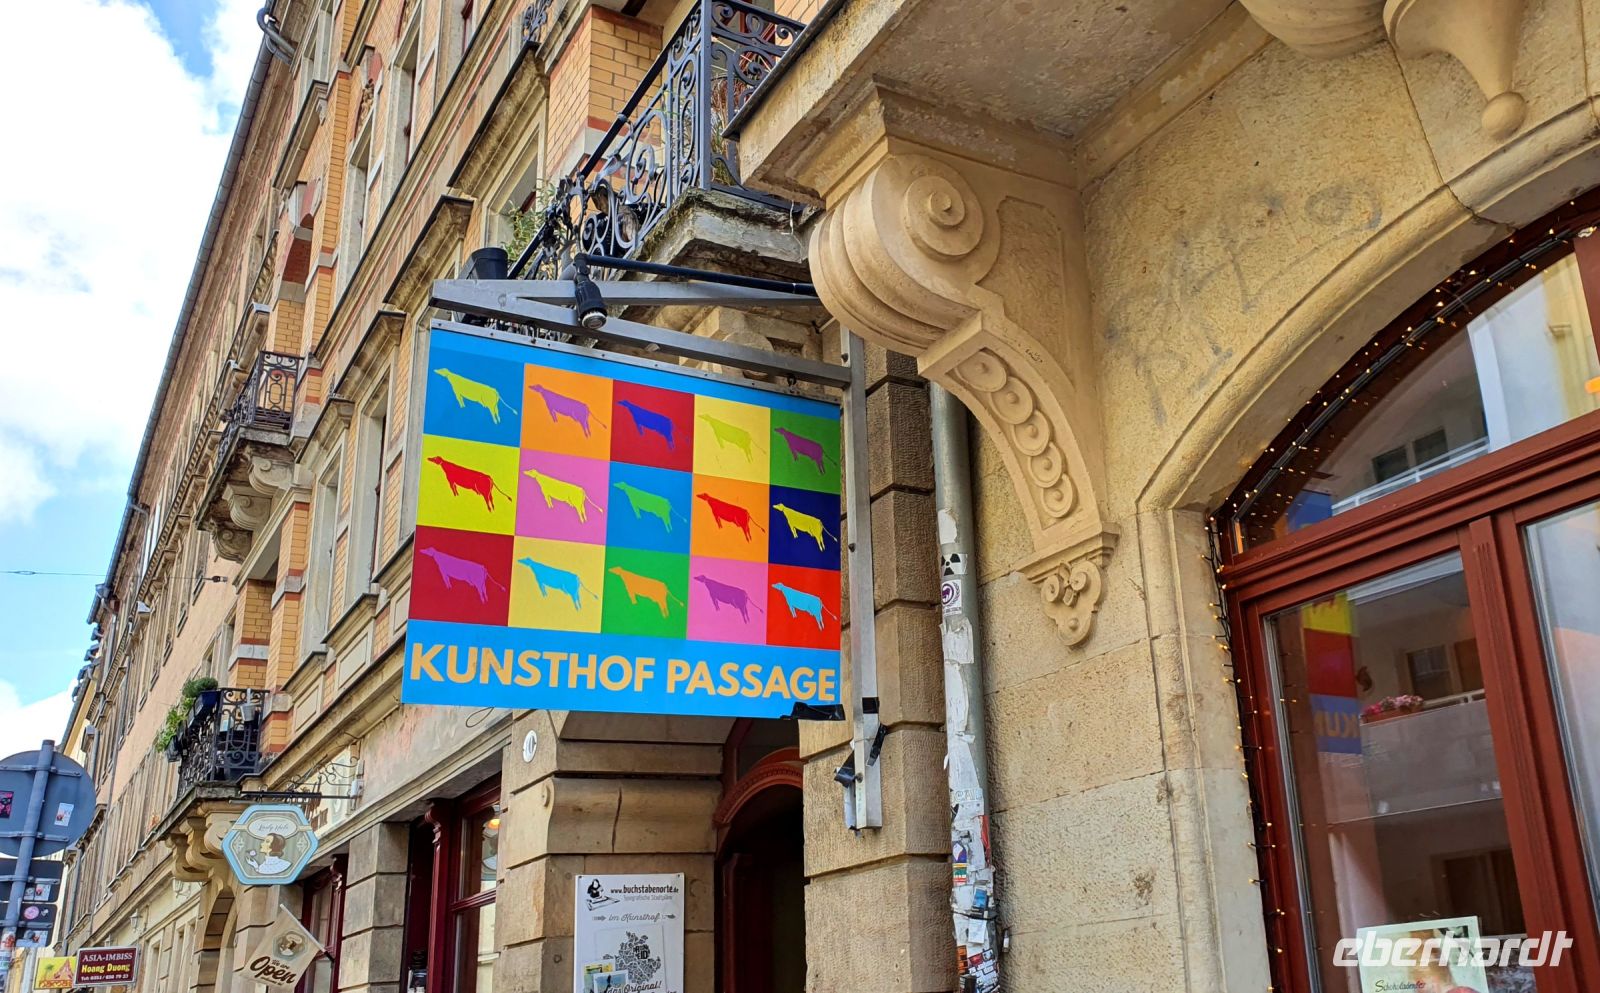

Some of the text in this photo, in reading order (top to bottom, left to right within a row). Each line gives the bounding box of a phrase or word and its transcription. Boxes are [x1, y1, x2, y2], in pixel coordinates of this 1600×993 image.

[409, 642, 837, 701] KUNSTHOF PASSAGE
[610, 884, 679, 894] www.buchstabenorte.de
[621, 912, 661, 923] Kunsthof
[82, 953, 133, 962] ASIA-IMBISS
[81, 962, 131, 973] Hoang Duong
[250, 956, 297, 984] Open
